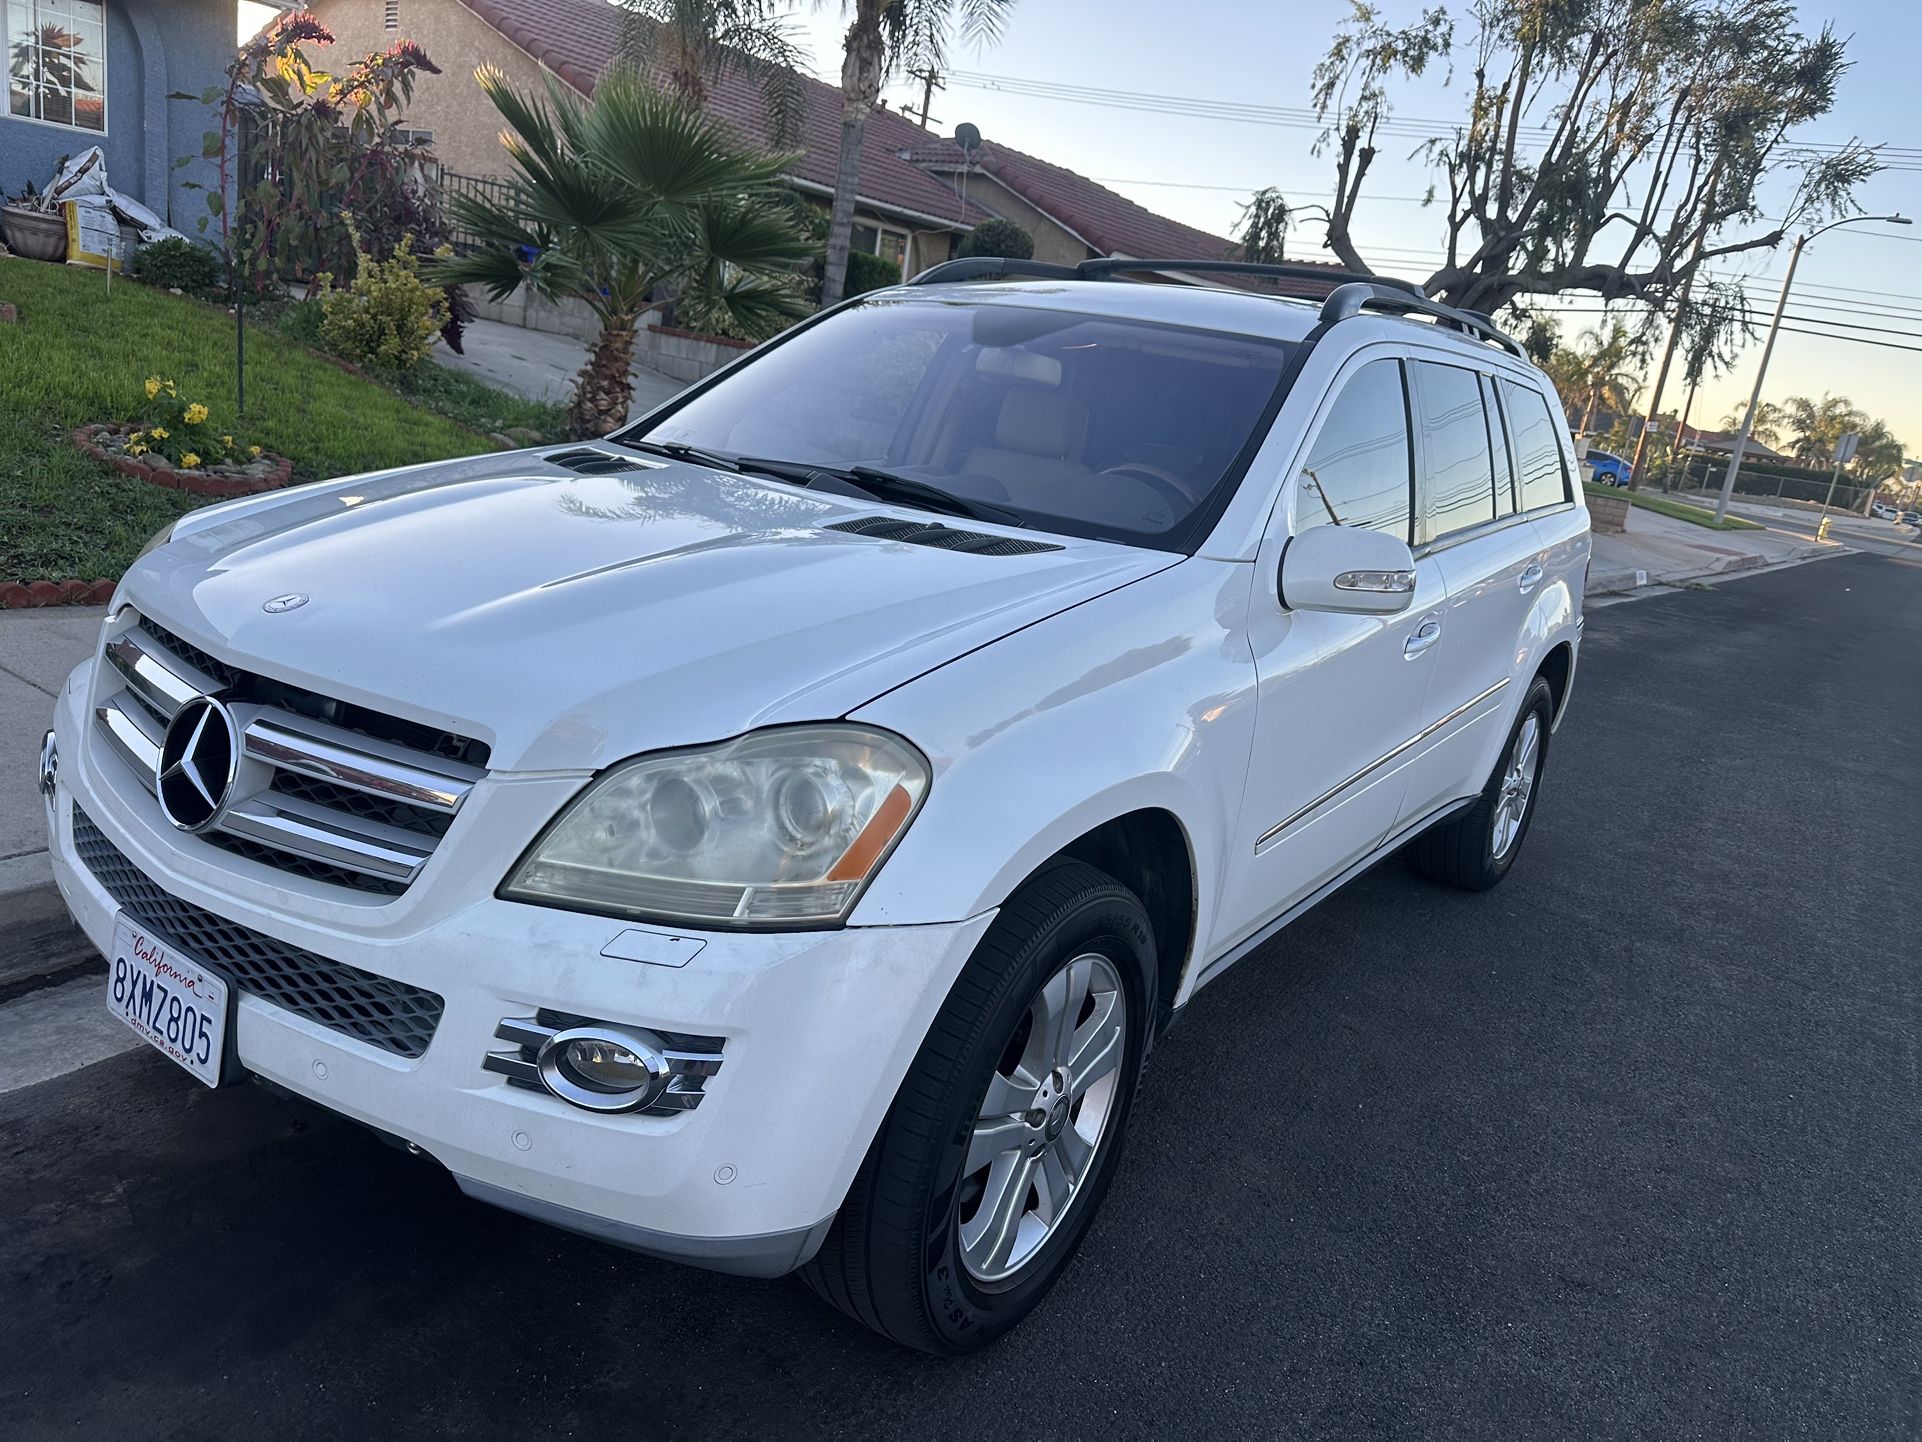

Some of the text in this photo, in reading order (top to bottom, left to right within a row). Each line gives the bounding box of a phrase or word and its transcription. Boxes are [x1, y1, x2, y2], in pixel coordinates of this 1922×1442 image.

[134, 936, 202, 998] California
[113, 957, 212, 1065] 8XMZ805
[130, 1017, 188, 1062] dmv.ca.gov
